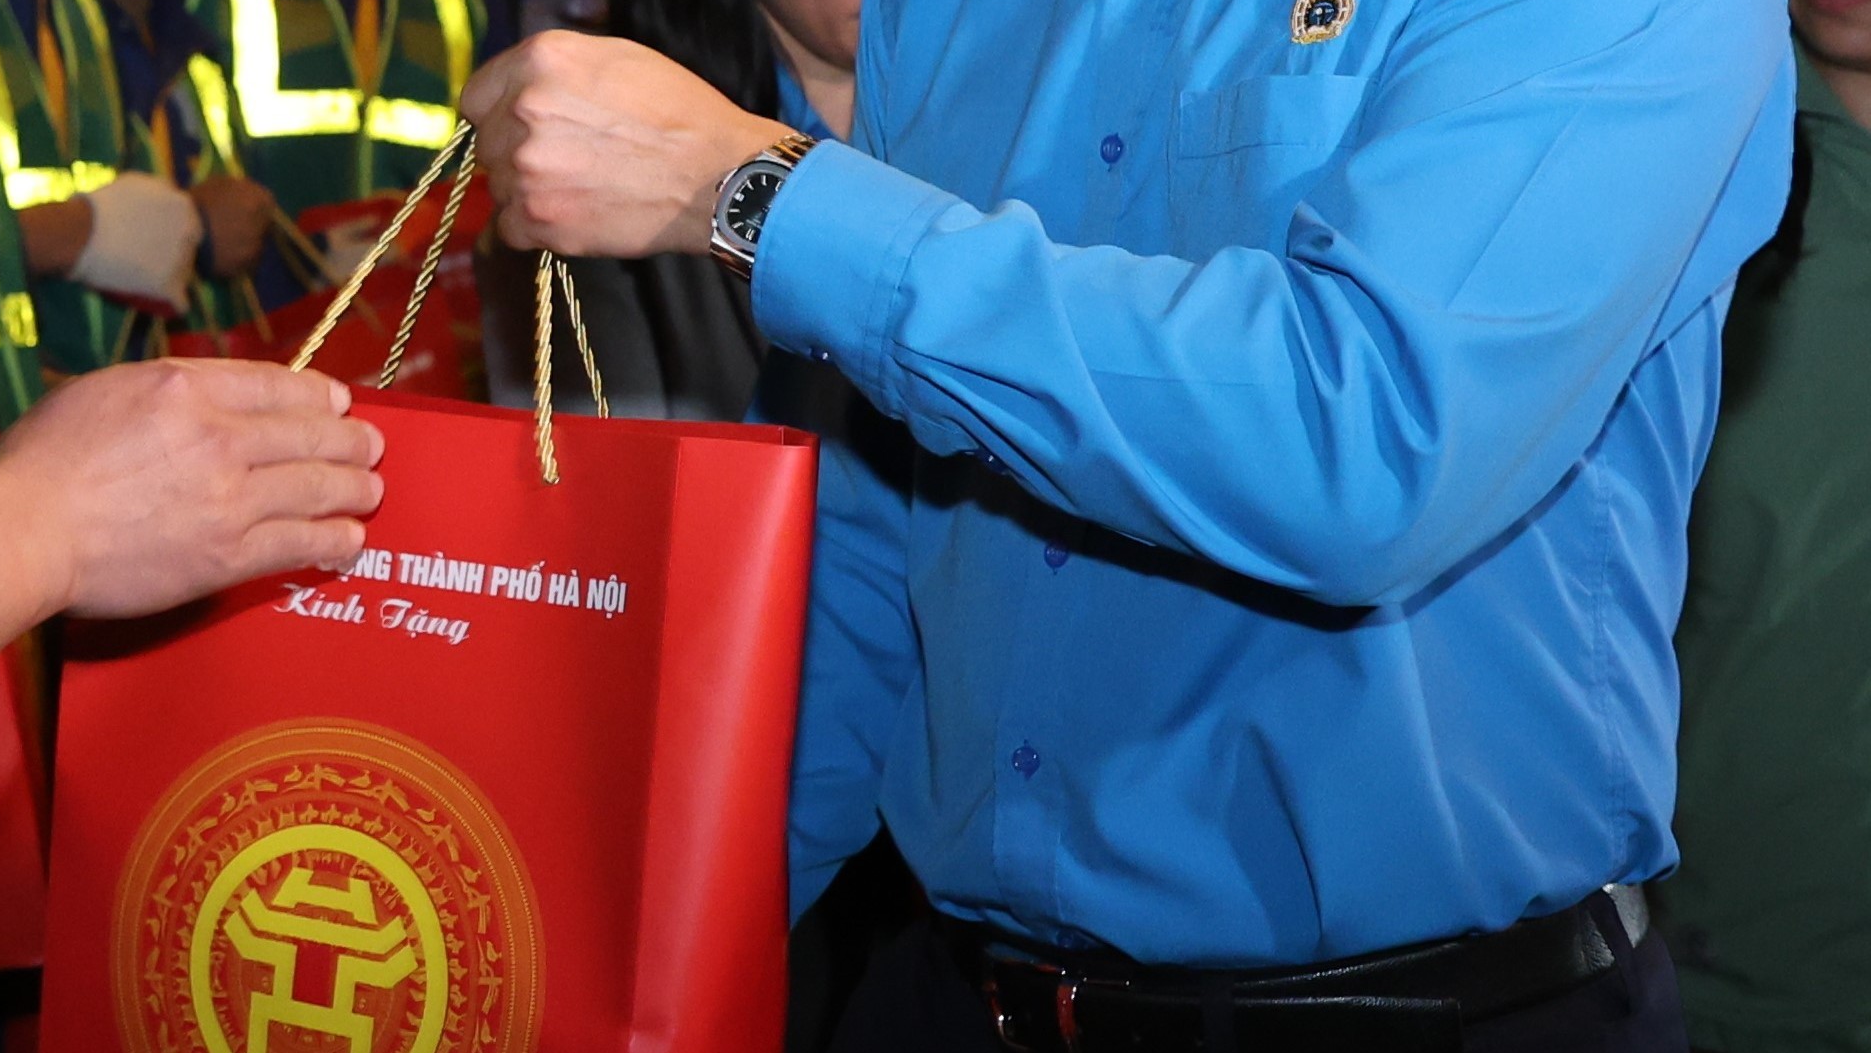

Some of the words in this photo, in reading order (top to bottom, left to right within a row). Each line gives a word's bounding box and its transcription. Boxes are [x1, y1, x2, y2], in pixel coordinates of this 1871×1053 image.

[272, 583, 366, 624] Kính
[380, 598, 470, 645] Tặng
[339, 548, 393, 582] NG
[399, 551, 485, 594] THÀNH
[489, 560, 545, 602] PHỐ
[547, 569, 580, 607] HÀ
[586, 574, 627, 619] NỘI
